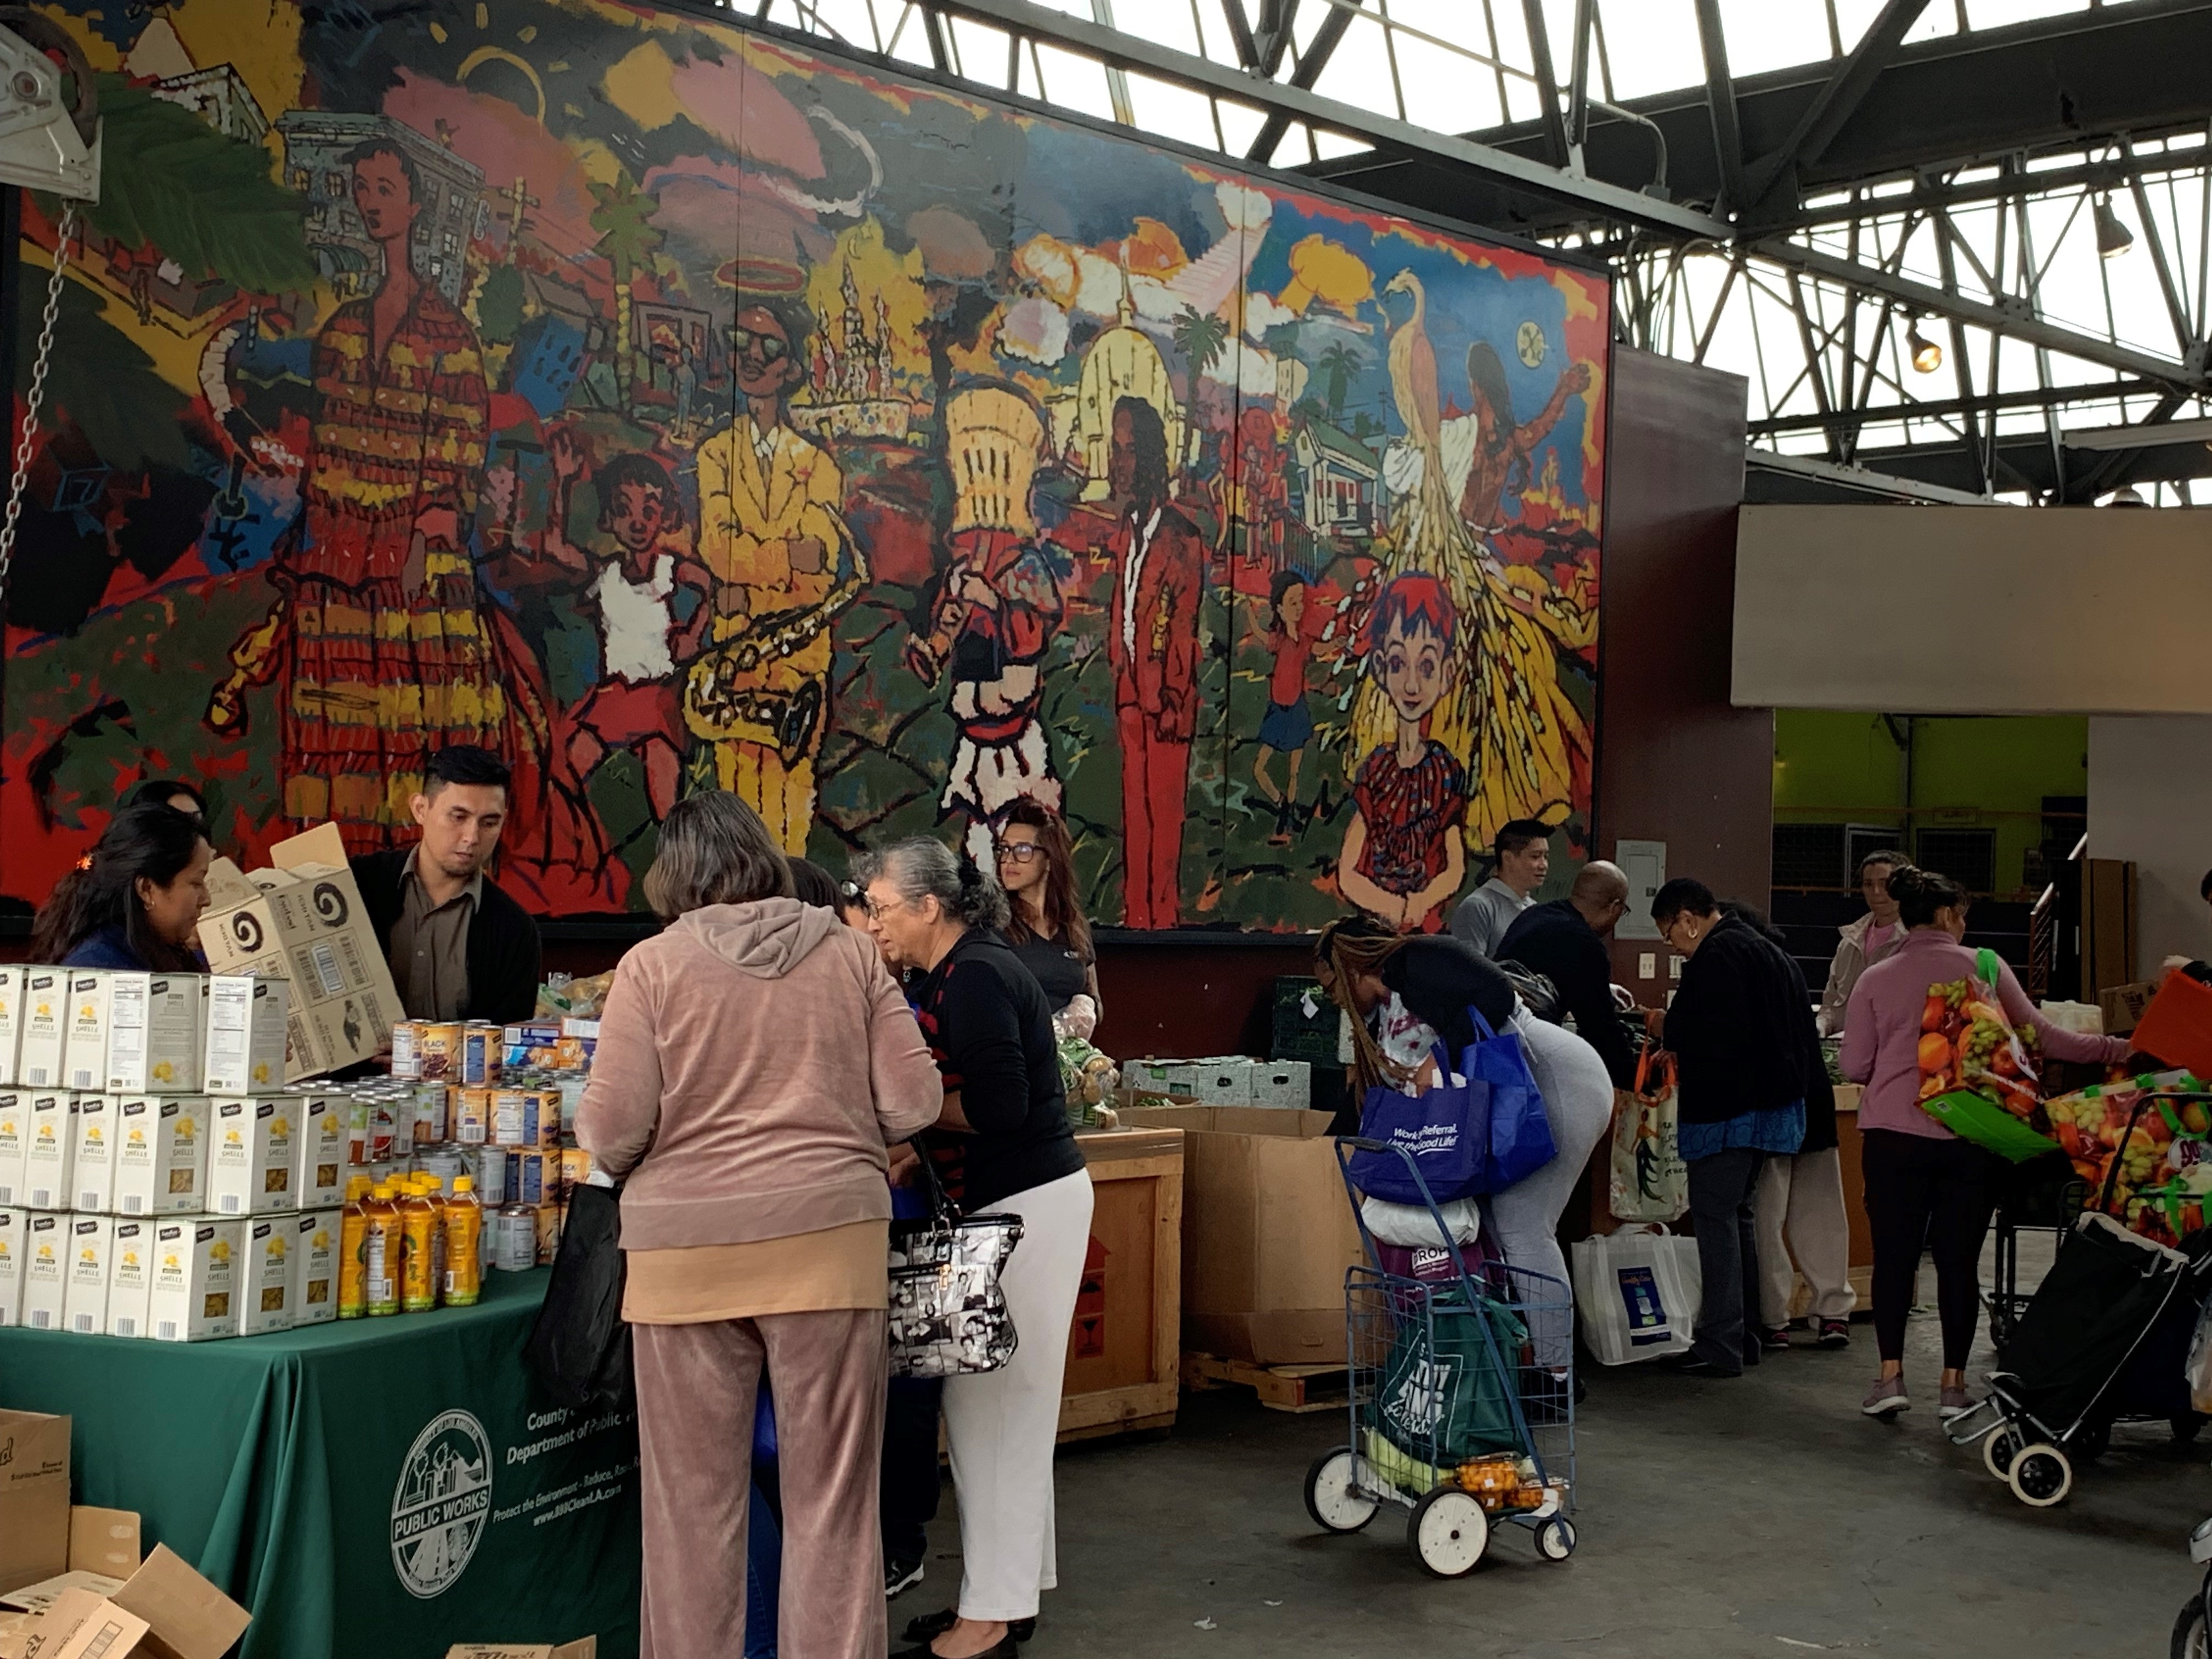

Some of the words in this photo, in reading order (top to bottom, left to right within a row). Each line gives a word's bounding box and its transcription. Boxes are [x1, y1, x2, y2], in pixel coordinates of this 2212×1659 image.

[1394, 1127, 1417, 1140] Work
[1422, 1123, 1458, 1135] Referral.
[83, 1147, 105, 1155] SHELLS
[268, 1149, 288, 1157] SHELLS
[76, 1268, 99, 1277] SHELLS
[119, 1272, 142, 1280] SHELLS
[207, 1272, 229, 1282] SHELLS
[264, 1268, 285, 1277] SHELLS
[160, 1275, 183, 1284] SHELLS
[527, 1406, 569, 1431] County
[506, 1427, 575, 1465] Department
[577, 1419, 589, 1440] of
[589, 1410, 622, 1435] Public
[493, 1504, 521, 1524] Protect
[522, 1497, 535, 1513] the
[535, 1481, 578, 1507] Environment
[394, 1507, 439, 1539] PUBLIC
[443, 1489, 488, 1521] WORKS
